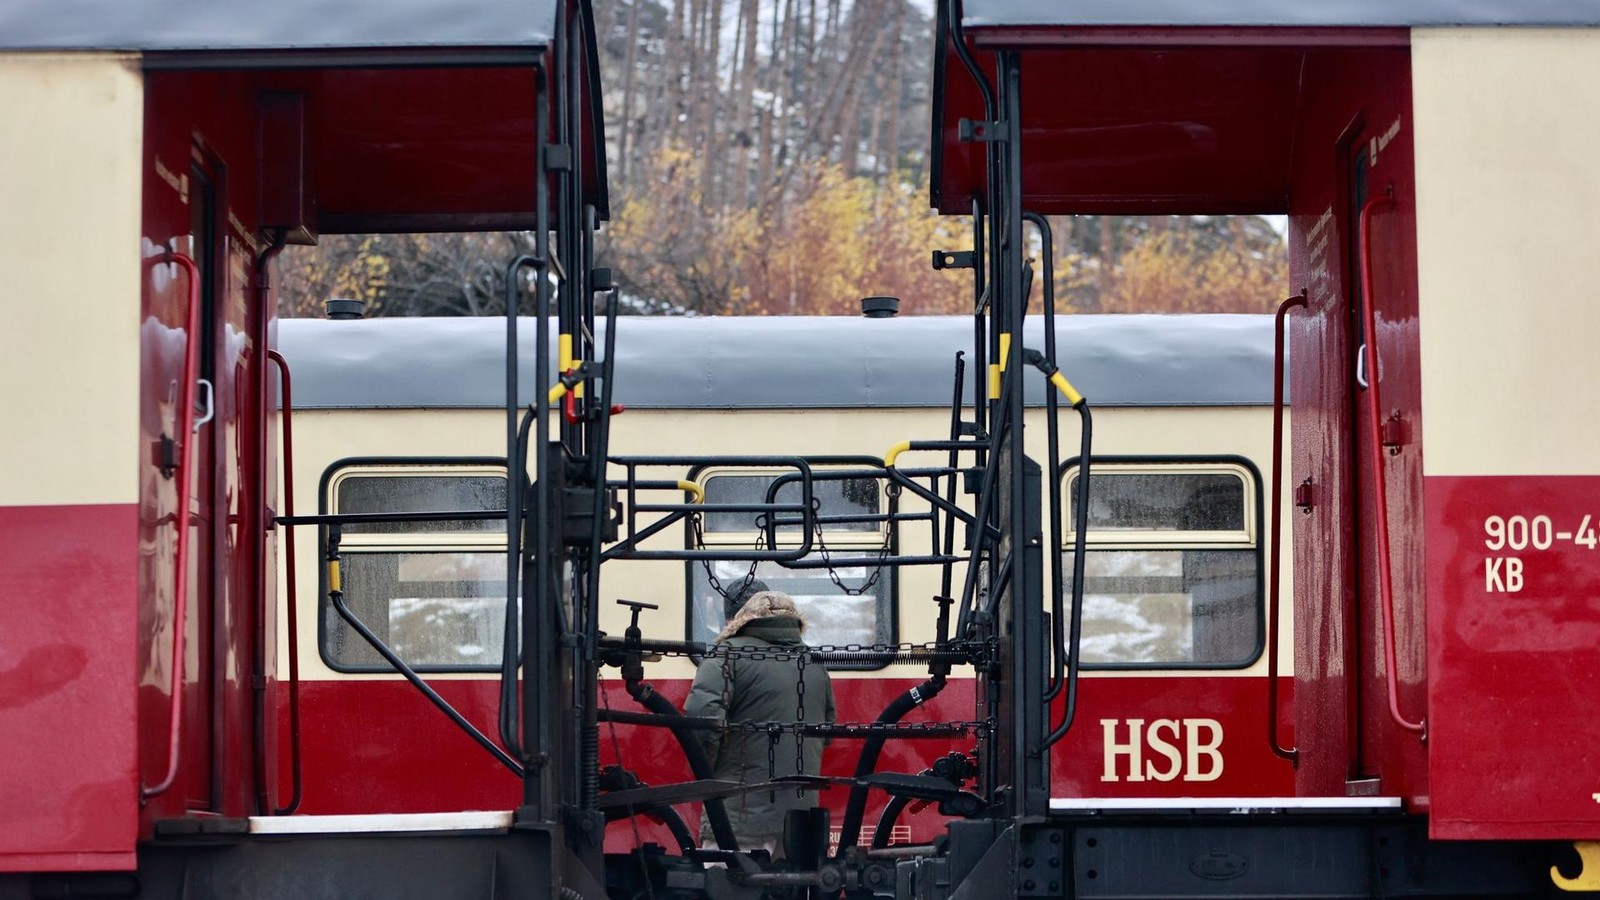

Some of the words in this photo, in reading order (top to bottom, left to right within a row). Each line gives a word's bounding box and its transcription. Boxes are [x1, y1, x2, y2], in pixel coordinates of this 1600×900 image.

[1484, 514, 1600, 551] 900-4
[1485, 557, 1524, 593] KB
[1099, 718, 1224, 782] HSB
